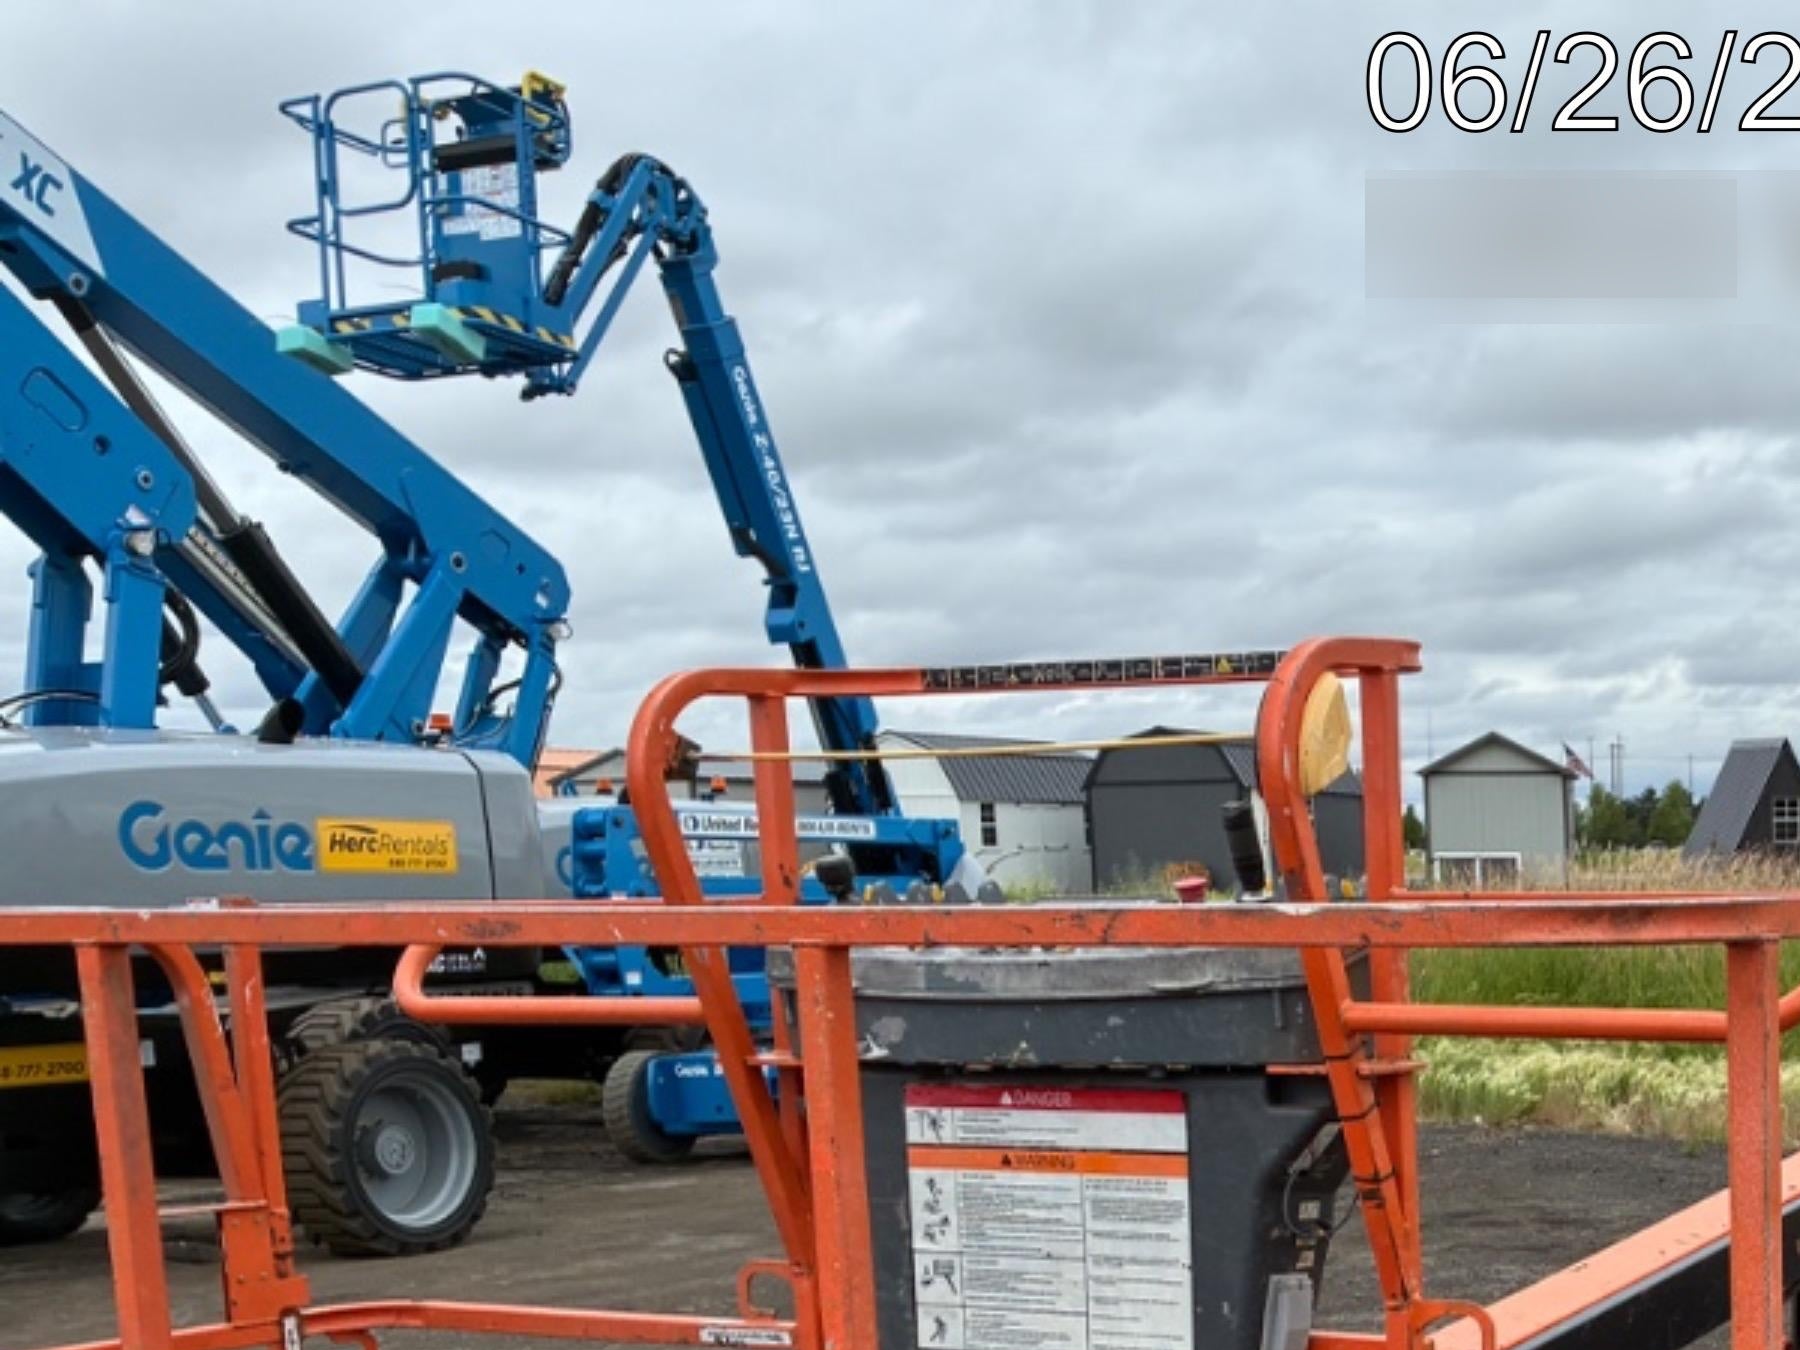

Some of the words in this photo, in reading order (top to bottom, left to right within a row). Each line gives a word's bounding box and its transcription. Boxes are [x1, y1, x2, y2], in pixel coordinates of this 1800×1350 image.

[10, 150, 63, 217] XC
[118, 799, 314, 872] Genie
[1012, 1091, 1073, 1108] DANGER
